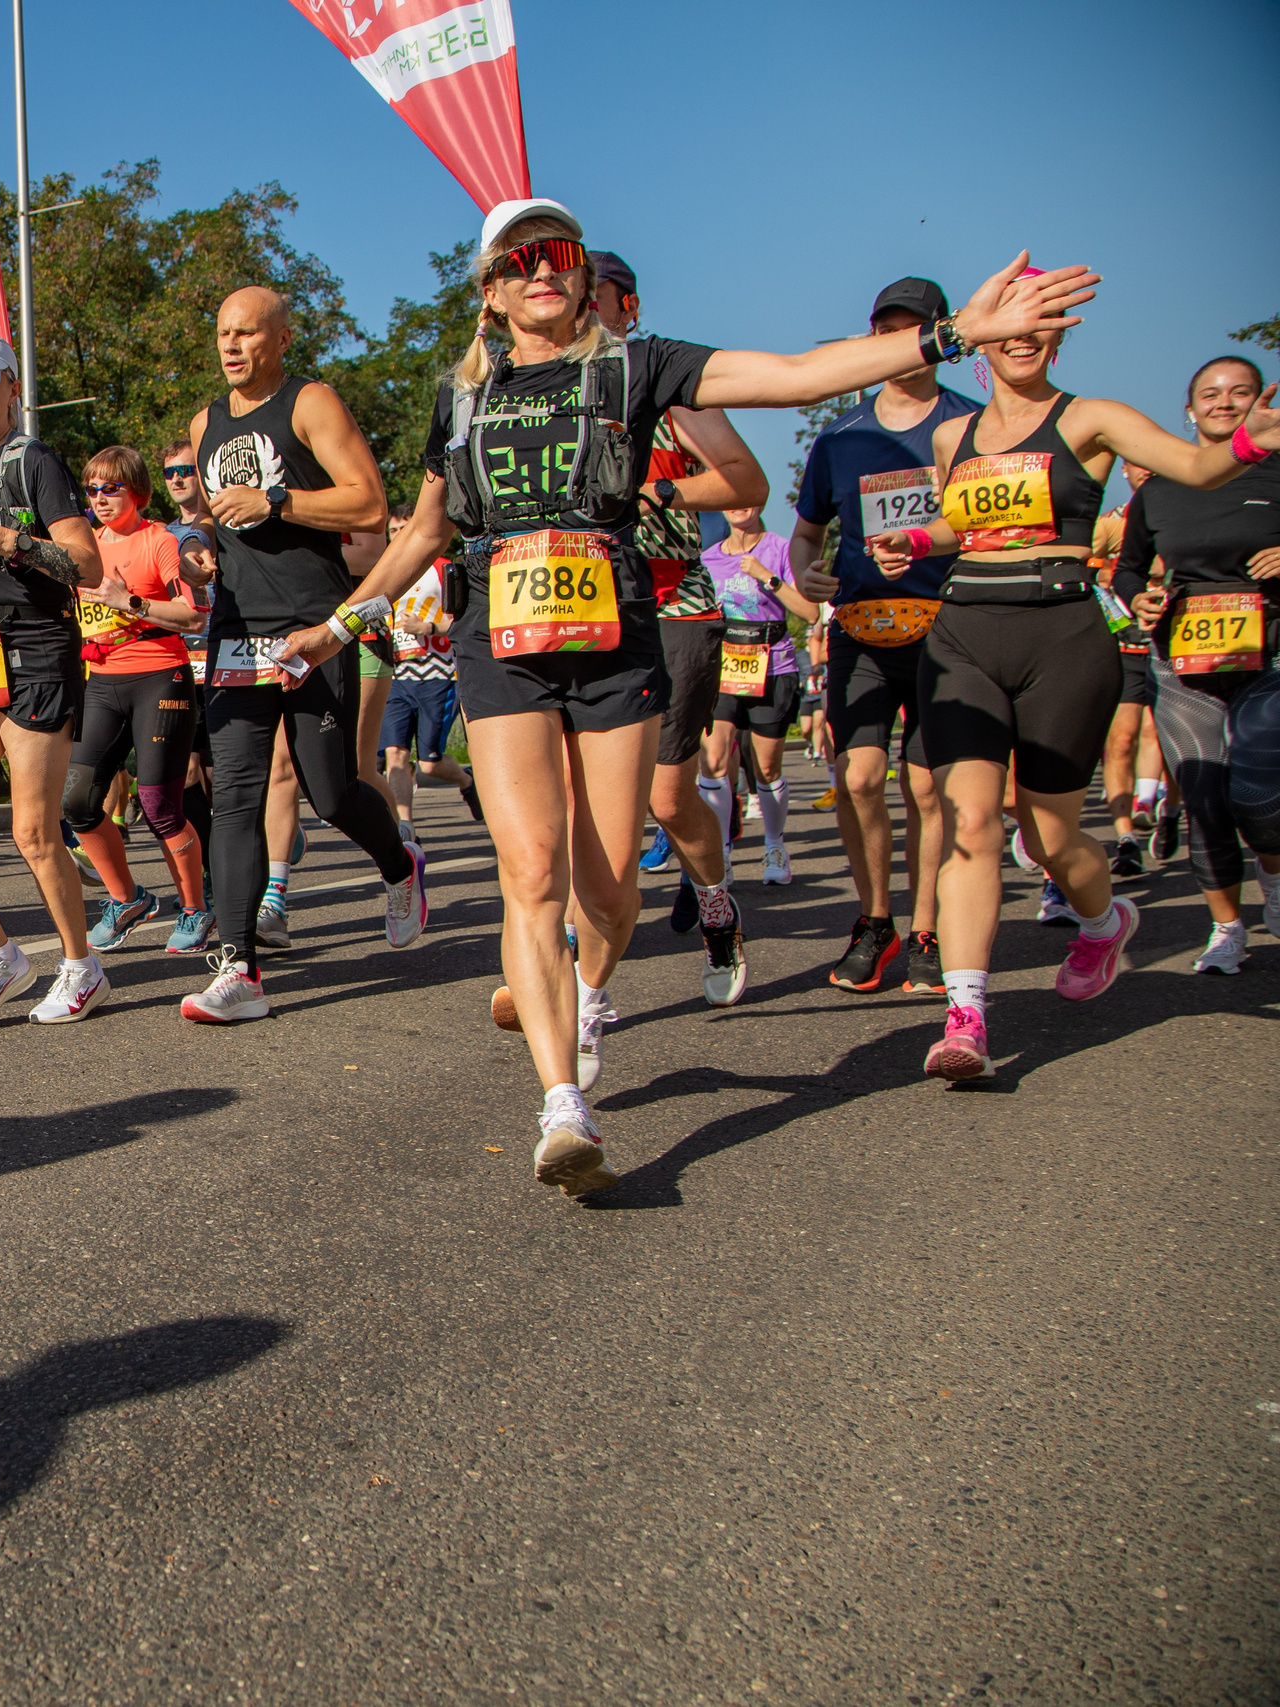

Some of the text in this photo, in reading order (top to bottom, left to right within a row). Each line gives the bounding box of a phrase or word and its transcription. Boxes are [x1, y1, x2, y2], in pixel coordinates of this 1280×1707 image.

[221, 434, 254, 461] OREGON
[220, 448, 258, 484] PROJECT
[877, 491, 941, 521] 1928
[958, 480, 1032, 517] 1884
[882, 516, 932, 529] АЛЕКСАНДР
[507, 566, 597, 605] 7886
[532, 605, 574, 616] ИРИНА
[727, 628, 760, 638] OWERUP
[1181, 616, 1247, 642] 6817
[501, 629, 516, 649] G
[1196, 641, 1226, 651] ДАРЬЯ
[722, 658, 759, 674] 4308
[1175, 657, 1184, 670] G
[220, 670, 231, 683] F
[158, 698, 179, 710] SPARTAN
